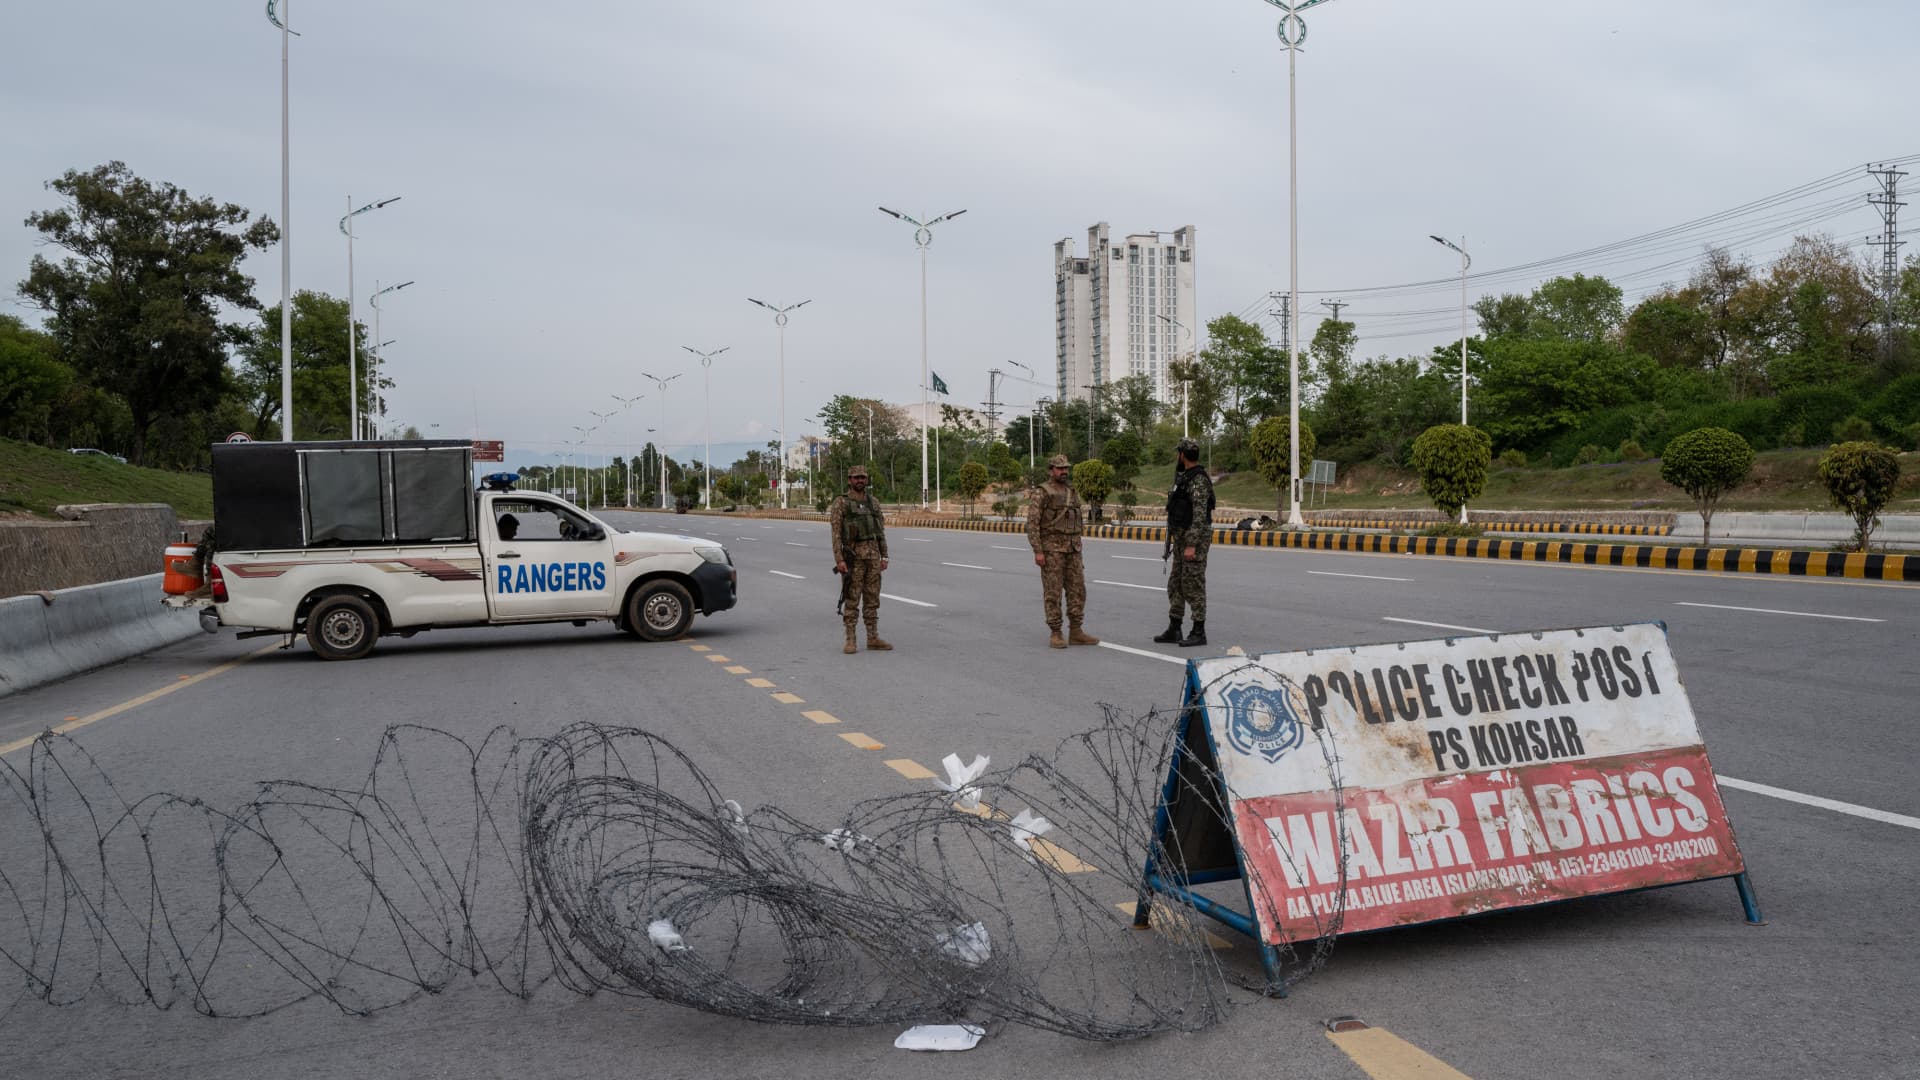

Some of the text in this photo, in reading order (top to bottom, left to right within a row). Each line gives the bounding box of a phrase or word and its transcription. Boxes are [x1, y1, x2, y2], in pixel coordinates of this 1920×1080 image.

[498, 561, 606, 593] RANGERS
[1304, 645, 1661, 730] POLICE CHECK POST
[1428, 715, 1585, 771] PS KOHSAR
[1264, 766, 1710, 889] WAZIR FABRICS
[1286, 896, 1311, 919] AA
[1401, 876, 1444, 901] AREA
